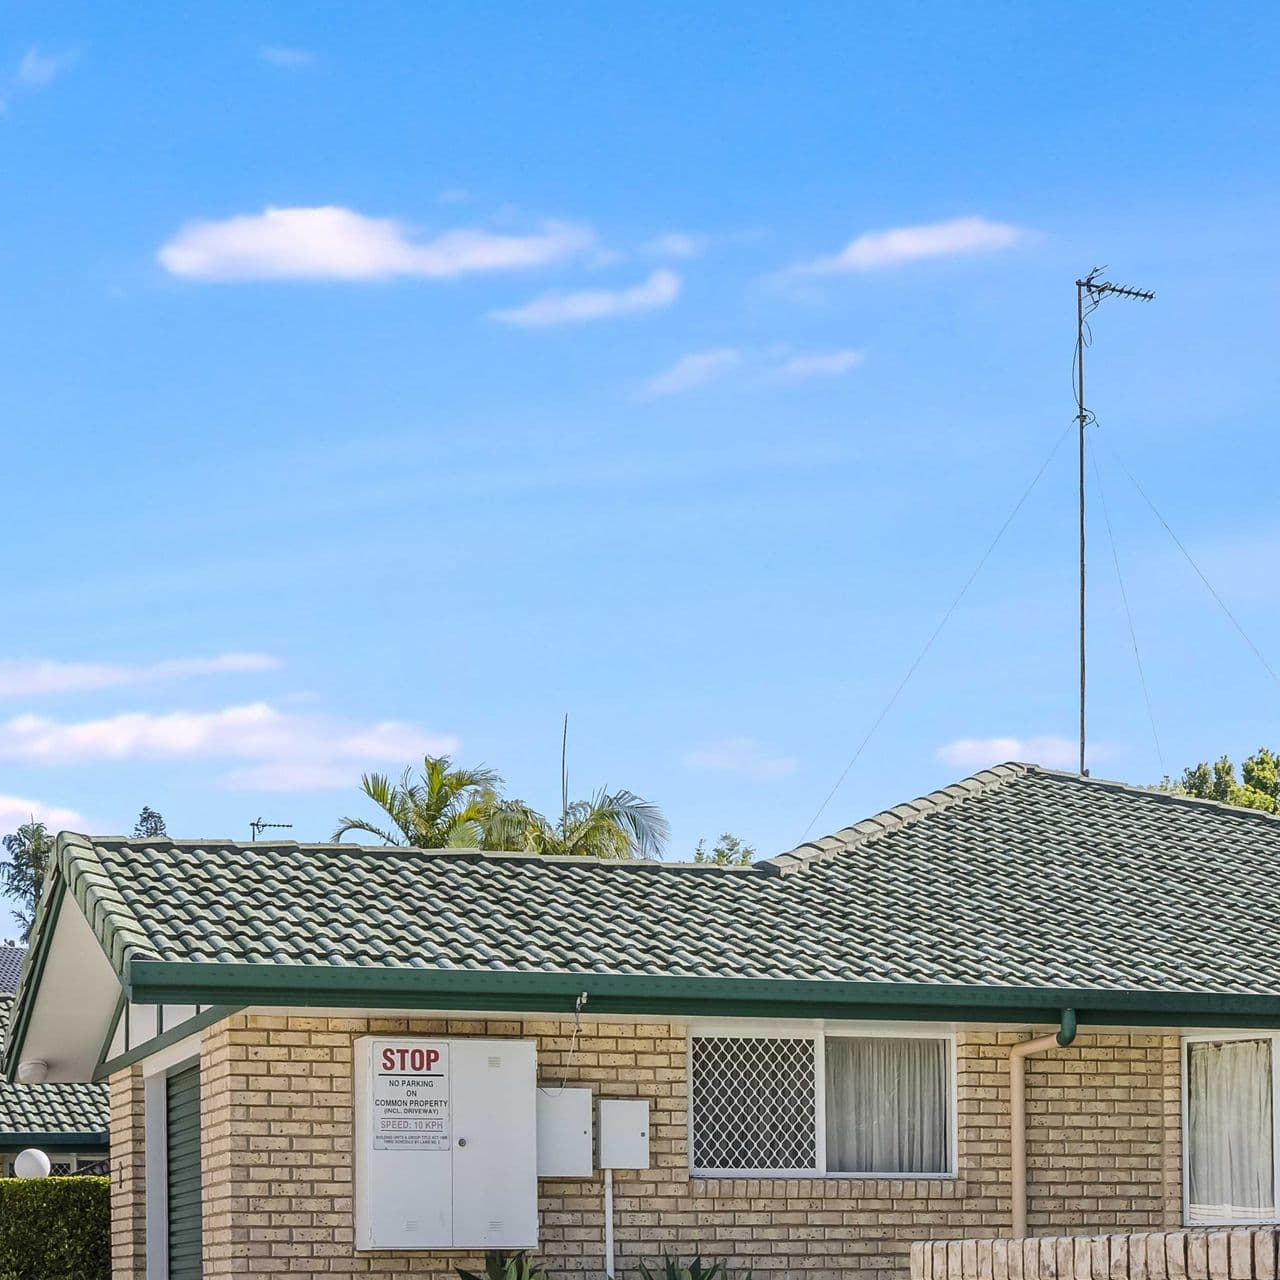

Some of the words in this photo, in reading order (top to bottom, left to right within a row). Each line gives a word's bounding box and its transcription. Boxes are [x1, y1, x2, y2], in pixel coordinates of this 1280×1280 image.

[382, 1048, 440, 1071] STOP
[402, 1080, 434, 1088] PARKING
[375, 1099, 408, 1107] COMMON
[410, 1099, 448, 1108] PROPERTY
[381, 1120, 412, 1129] SPEED:
[415, 1121, 424, 1129] 10
[425, 1121, 443, 1129] KPH
